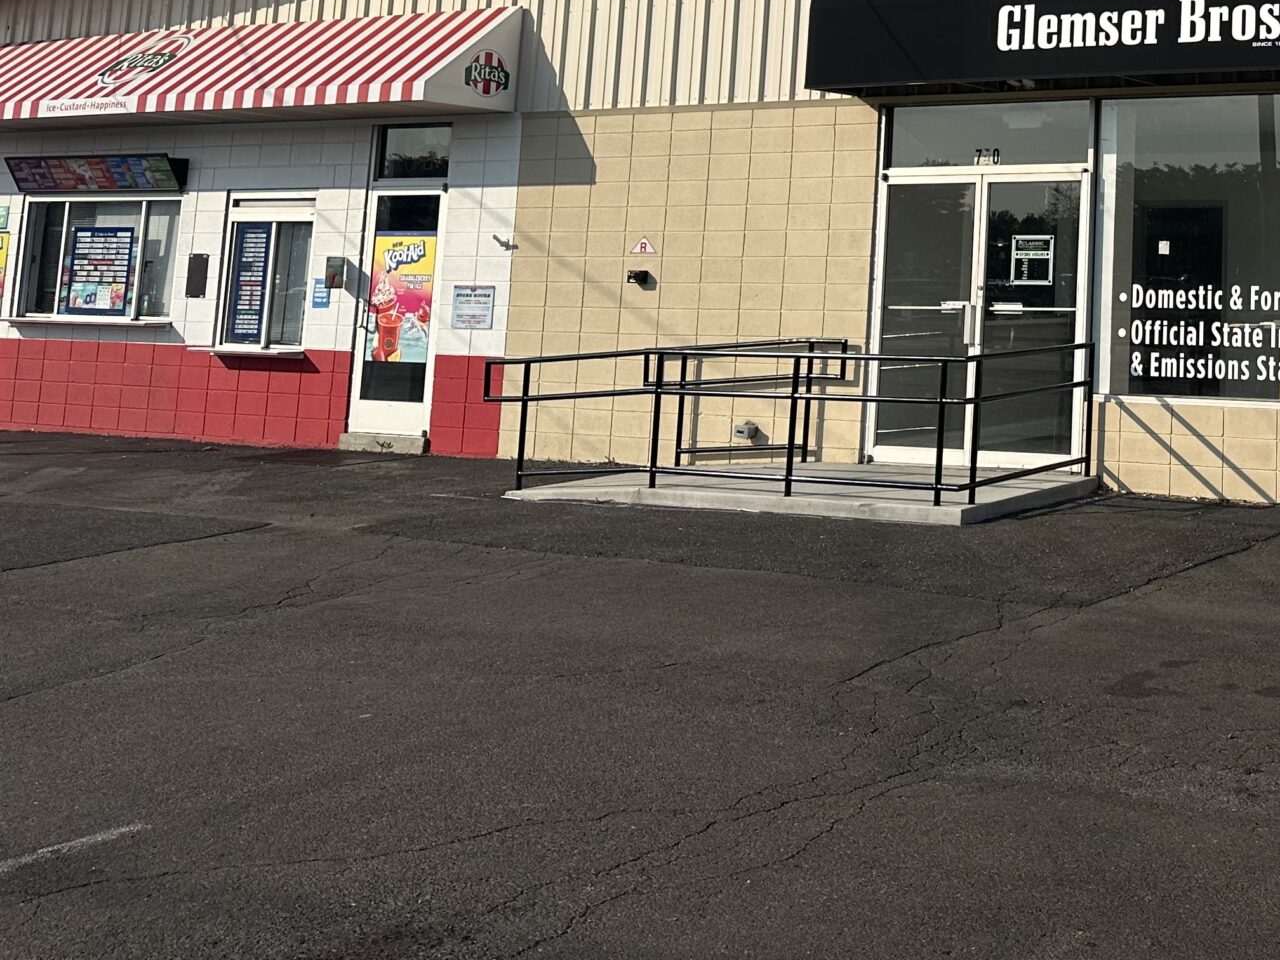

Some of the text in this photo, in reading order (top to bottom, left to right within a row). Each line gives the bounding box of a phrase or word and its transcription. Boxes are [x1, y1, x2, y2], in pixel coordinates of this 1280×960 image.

[996, 3, 1165, 52] Glemser
[116, 51, 170, 71] Rita's
[471, 61, 506, 84] Rita's
[975, 148, 1000, 165] 70
[1131, 283, 1223, 310] Domestic
[1229, 285, 1243, 311] &
[1130, 320, 1204, 347] Official
[1211, 321, 1263, 348] State
[1130, 351, 1143, 377] &
[1150, 352, 1250, 380] Emissions
